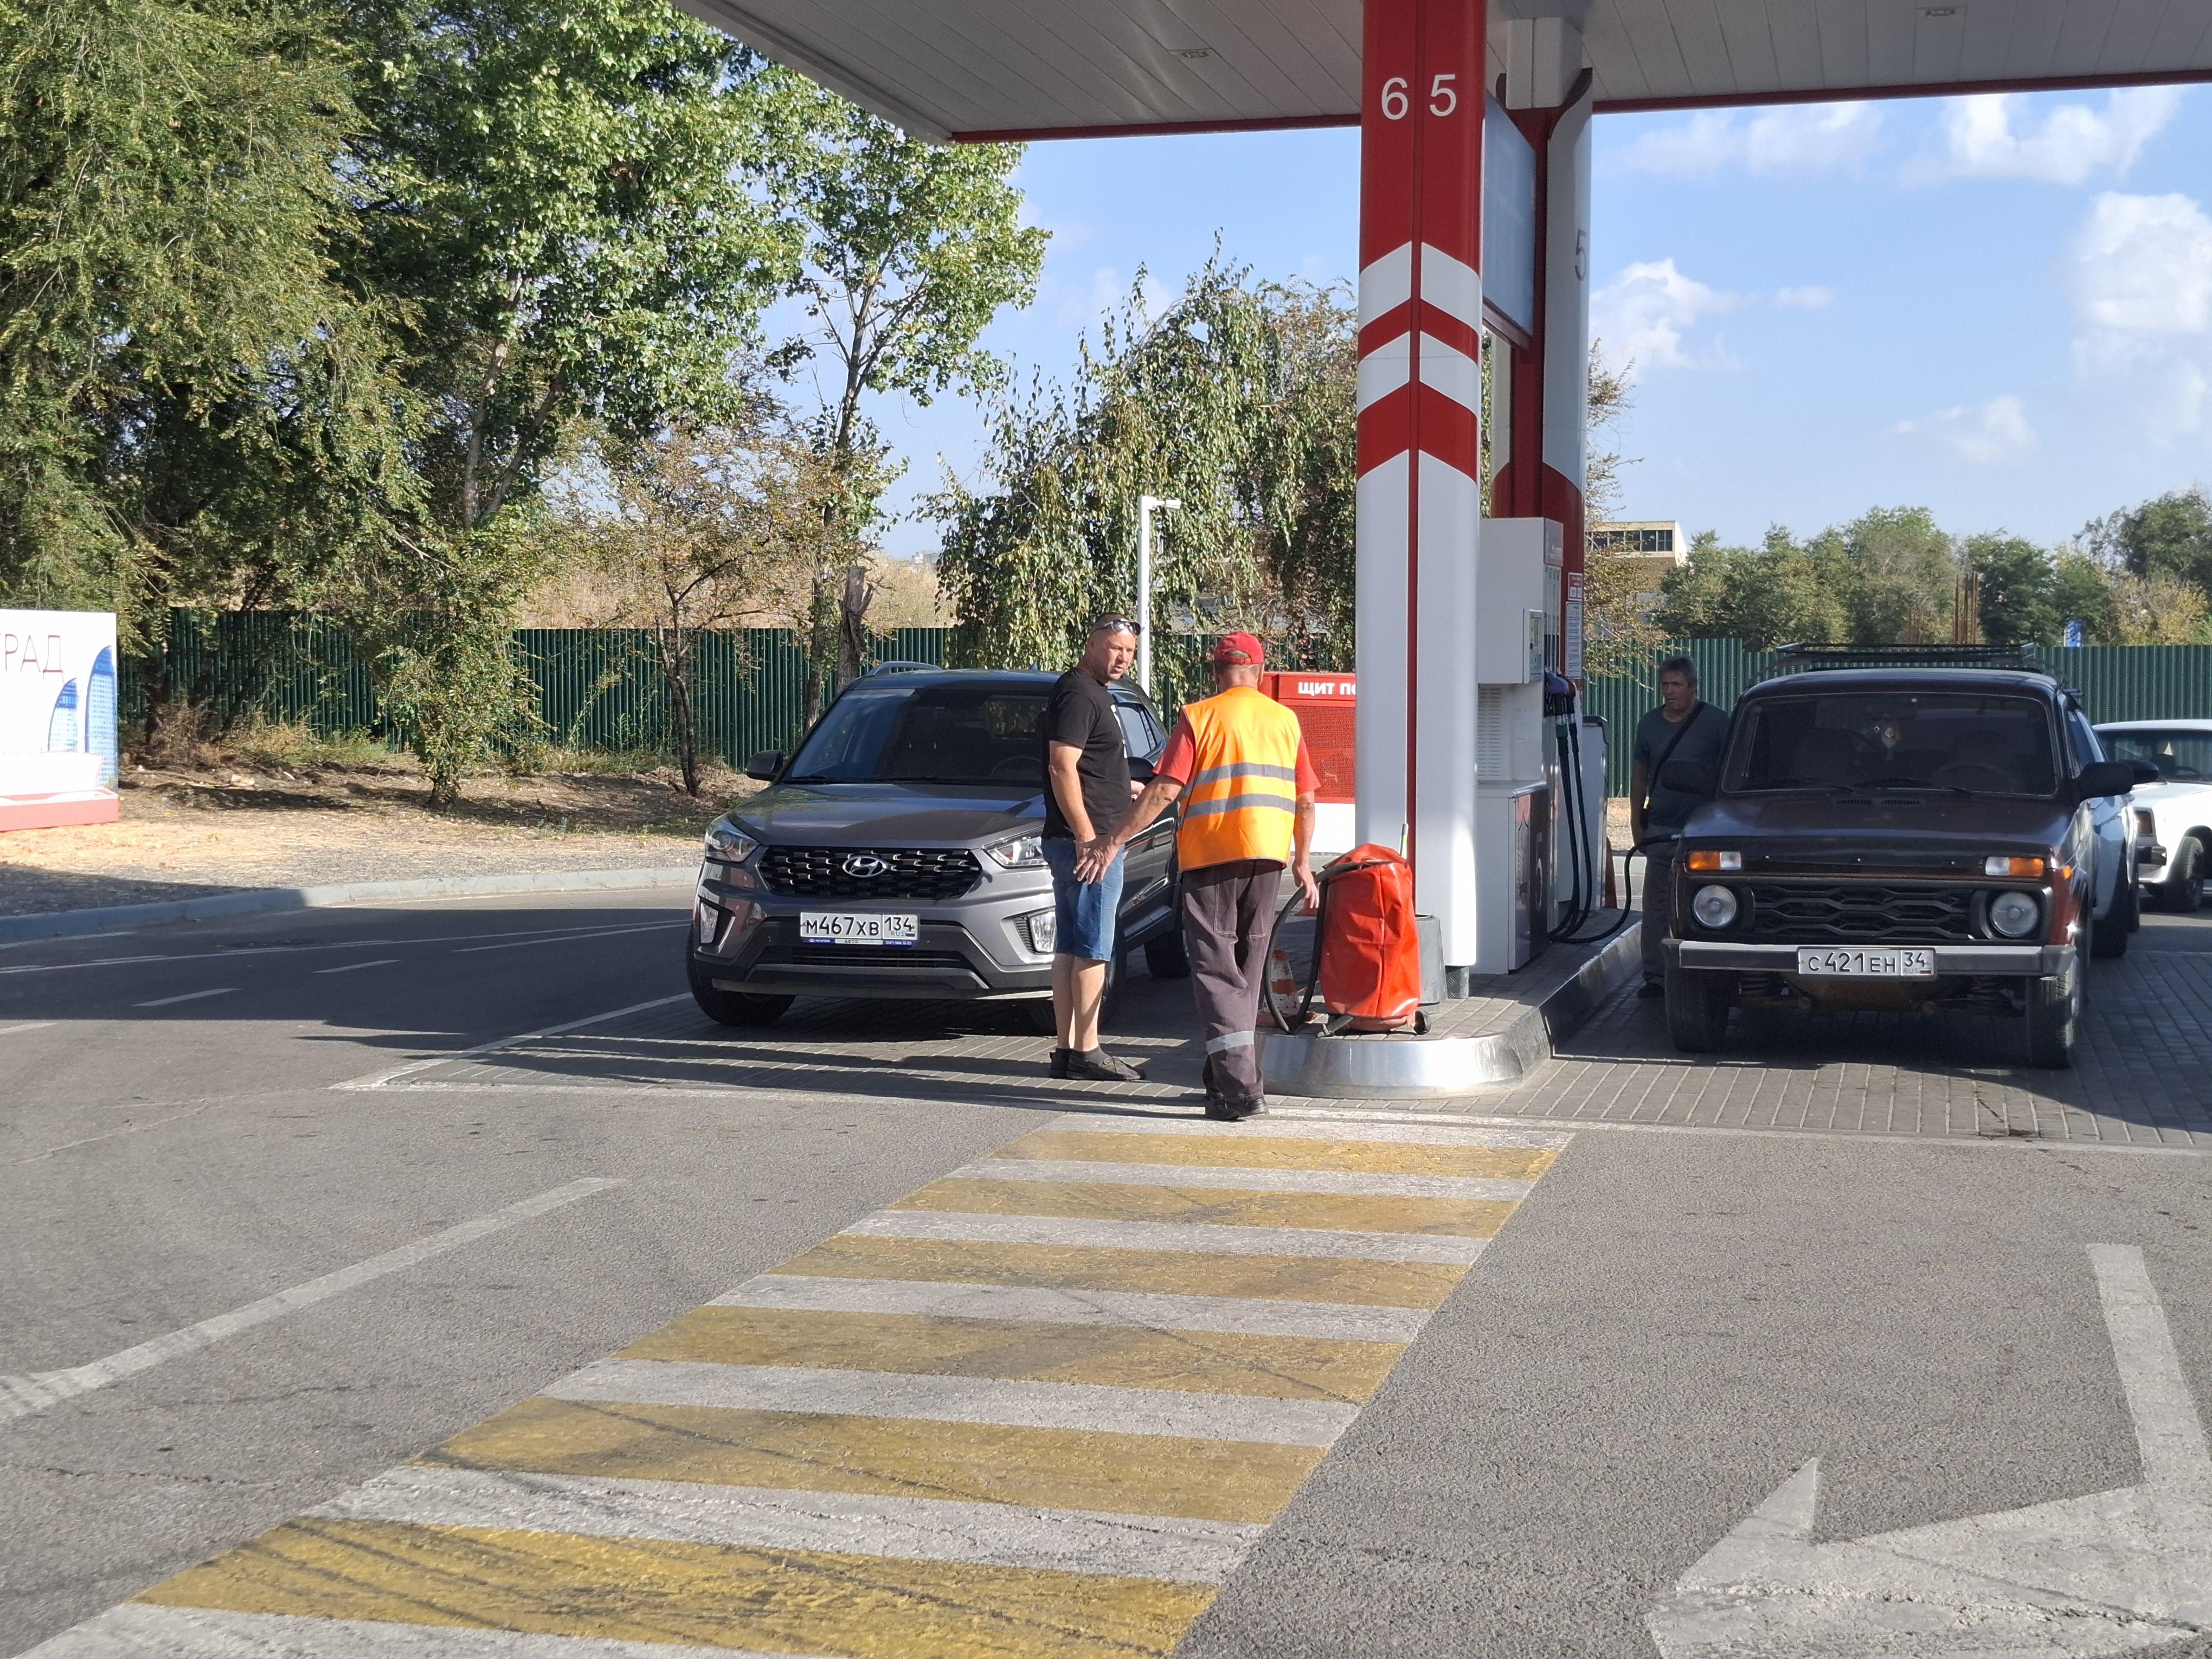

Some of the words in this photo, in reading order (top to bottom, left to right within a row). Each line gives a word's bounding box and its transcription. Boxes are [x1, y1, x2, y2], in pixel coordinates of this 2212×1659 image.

[1381, 78, 1409, 120] 6
[1429, 74, 1457, 117] 5
[1574, 229, 1587, 281] 5
[0, 633, 64, 683] РАД
[1298, 682, 1335, 696] ЩИТ
[806, 916, 880, 936] М467ХВ
[884, 916, 914, 931] 134
[1808, 952, 1896, 973] С421ЕН
[1904, 951, 1925, 967] 34
